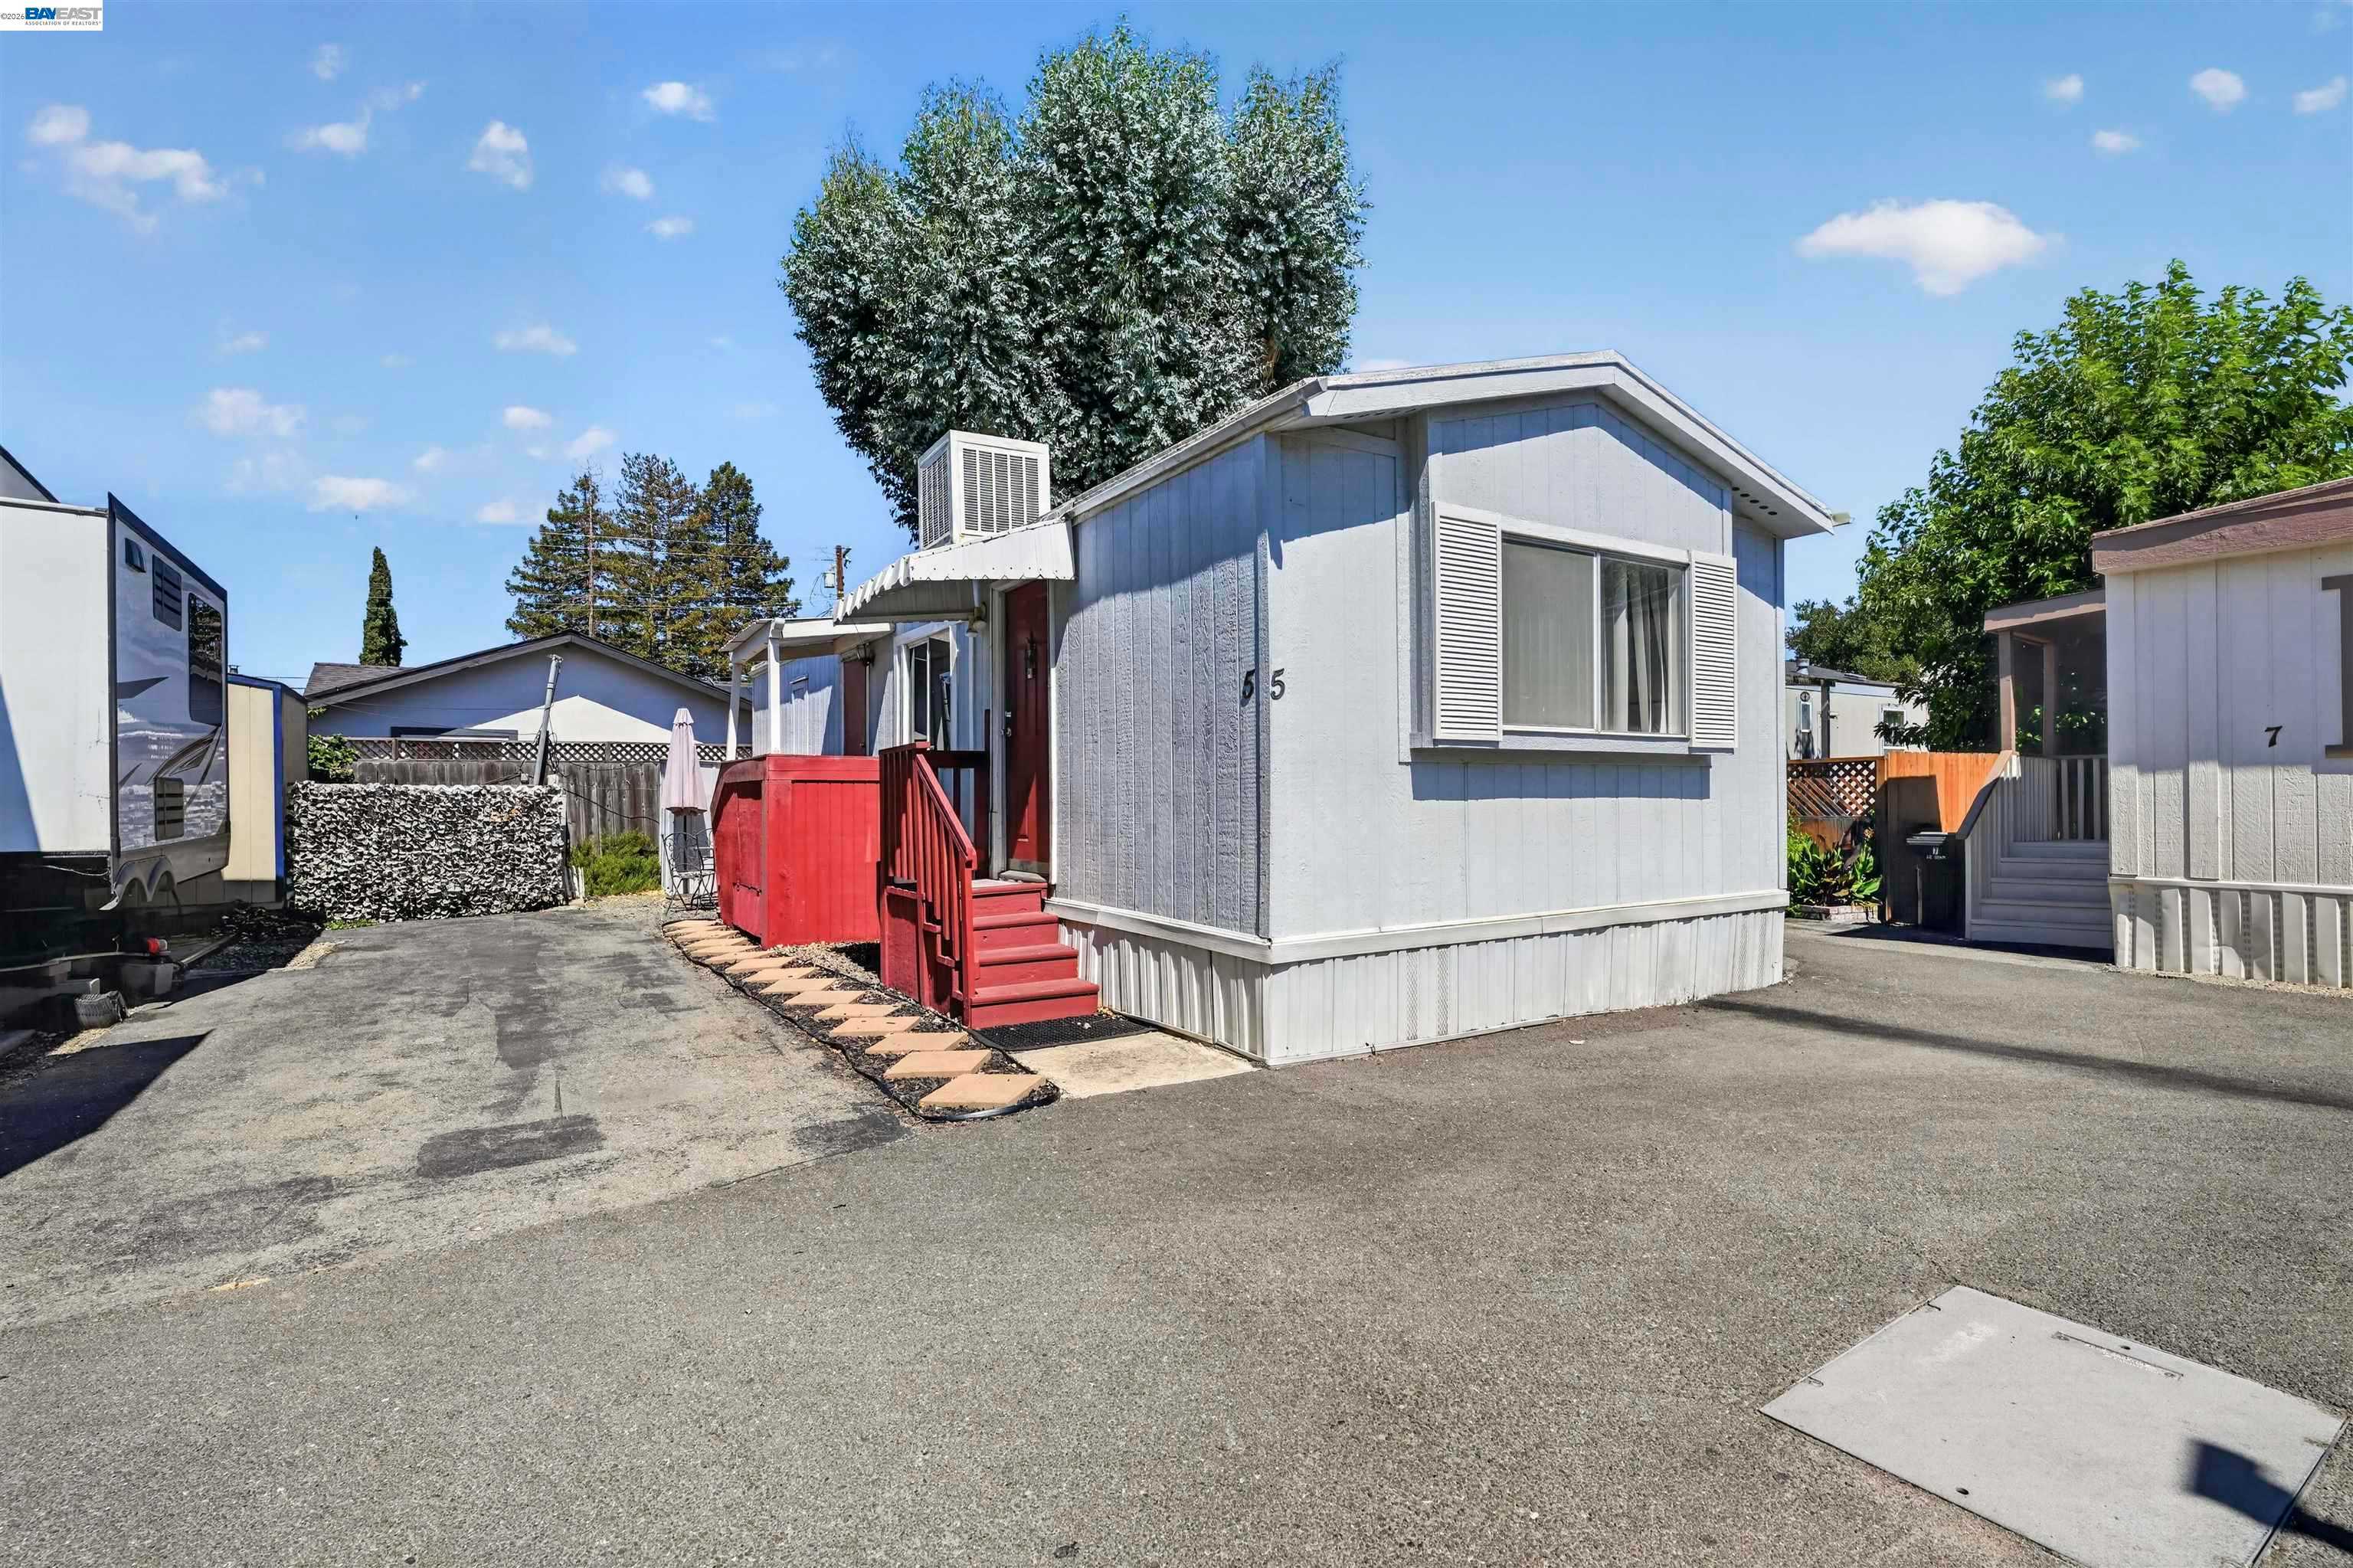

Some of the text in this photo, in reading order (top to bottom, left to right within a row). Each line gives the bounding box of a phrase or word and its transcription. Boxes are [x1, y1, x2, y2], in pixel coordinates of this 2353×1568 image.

[1242, 668, 1256, 699] 5
[1271, 668, 1285, 700] 5
[2264, 725, 2283, 748] 7
